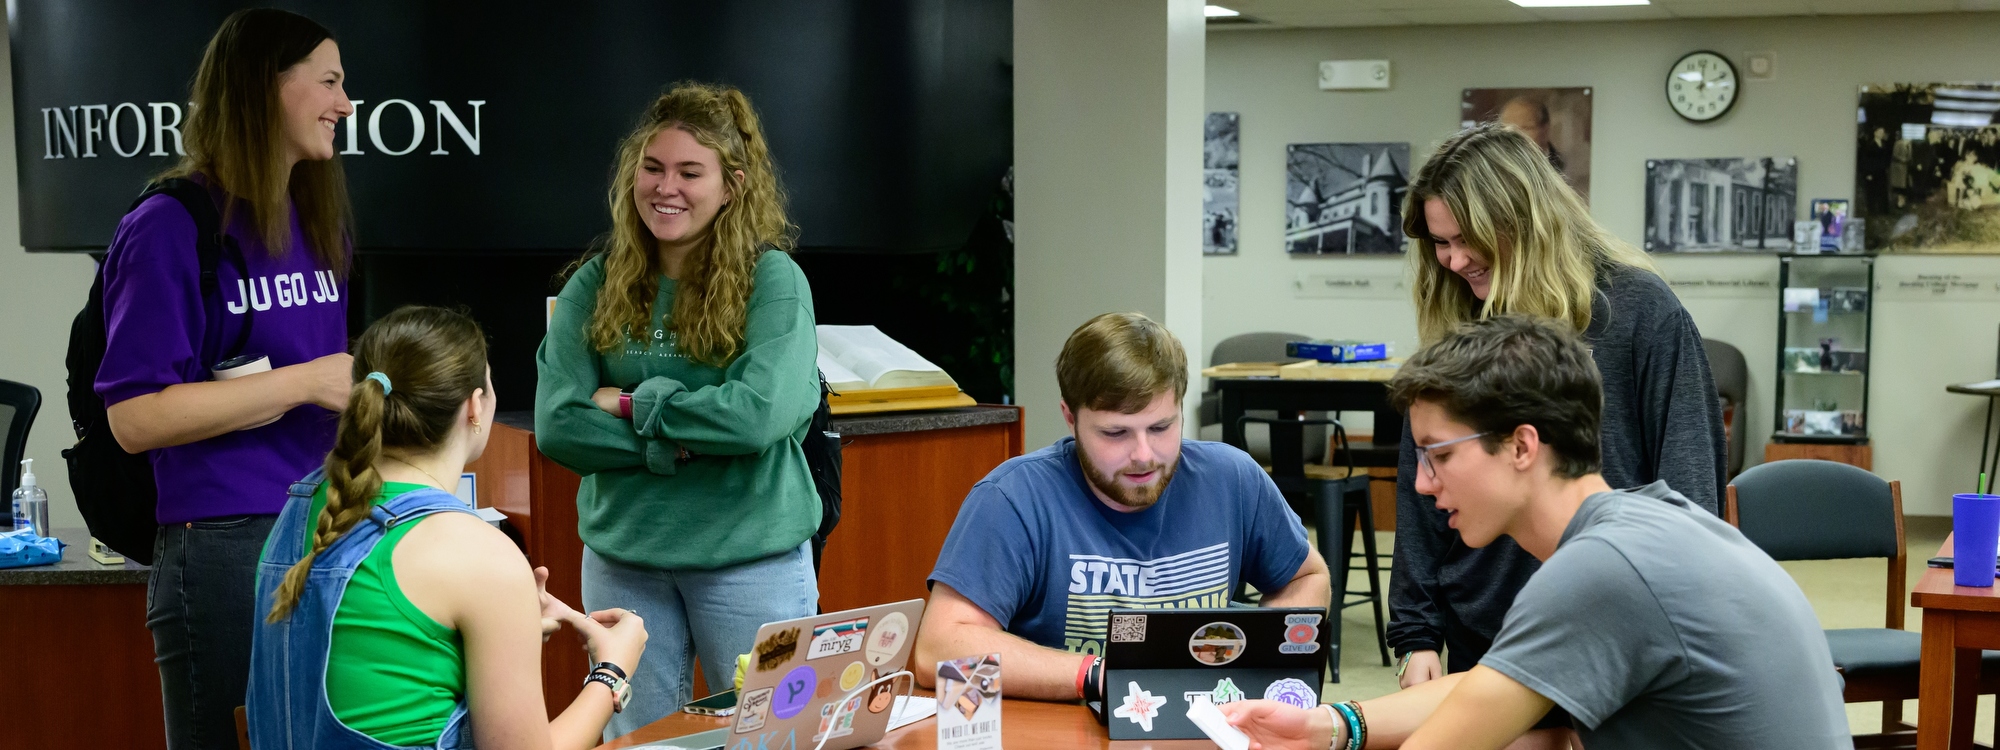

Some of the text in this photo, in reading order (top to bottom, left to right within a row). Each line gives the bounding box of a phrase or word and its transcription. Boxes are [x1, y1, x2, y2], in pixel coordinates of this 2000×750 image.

[41, 98, 486, 160] INFORION
[227, 269, 340, 315] JU GO JU
[1068, 560, 1157, 597] STATE
[1287, 616, 1318, 624] DONUT
[1282, 644, 1317, 652] GIVE UP
[819, 712, 854, 733] LFE
[941, 727, 950, 740] YOU
[952, 725, 963, 738] NEED
[971, 722, 978, 735] WE
[980, 720, 991, 733] HAVE
